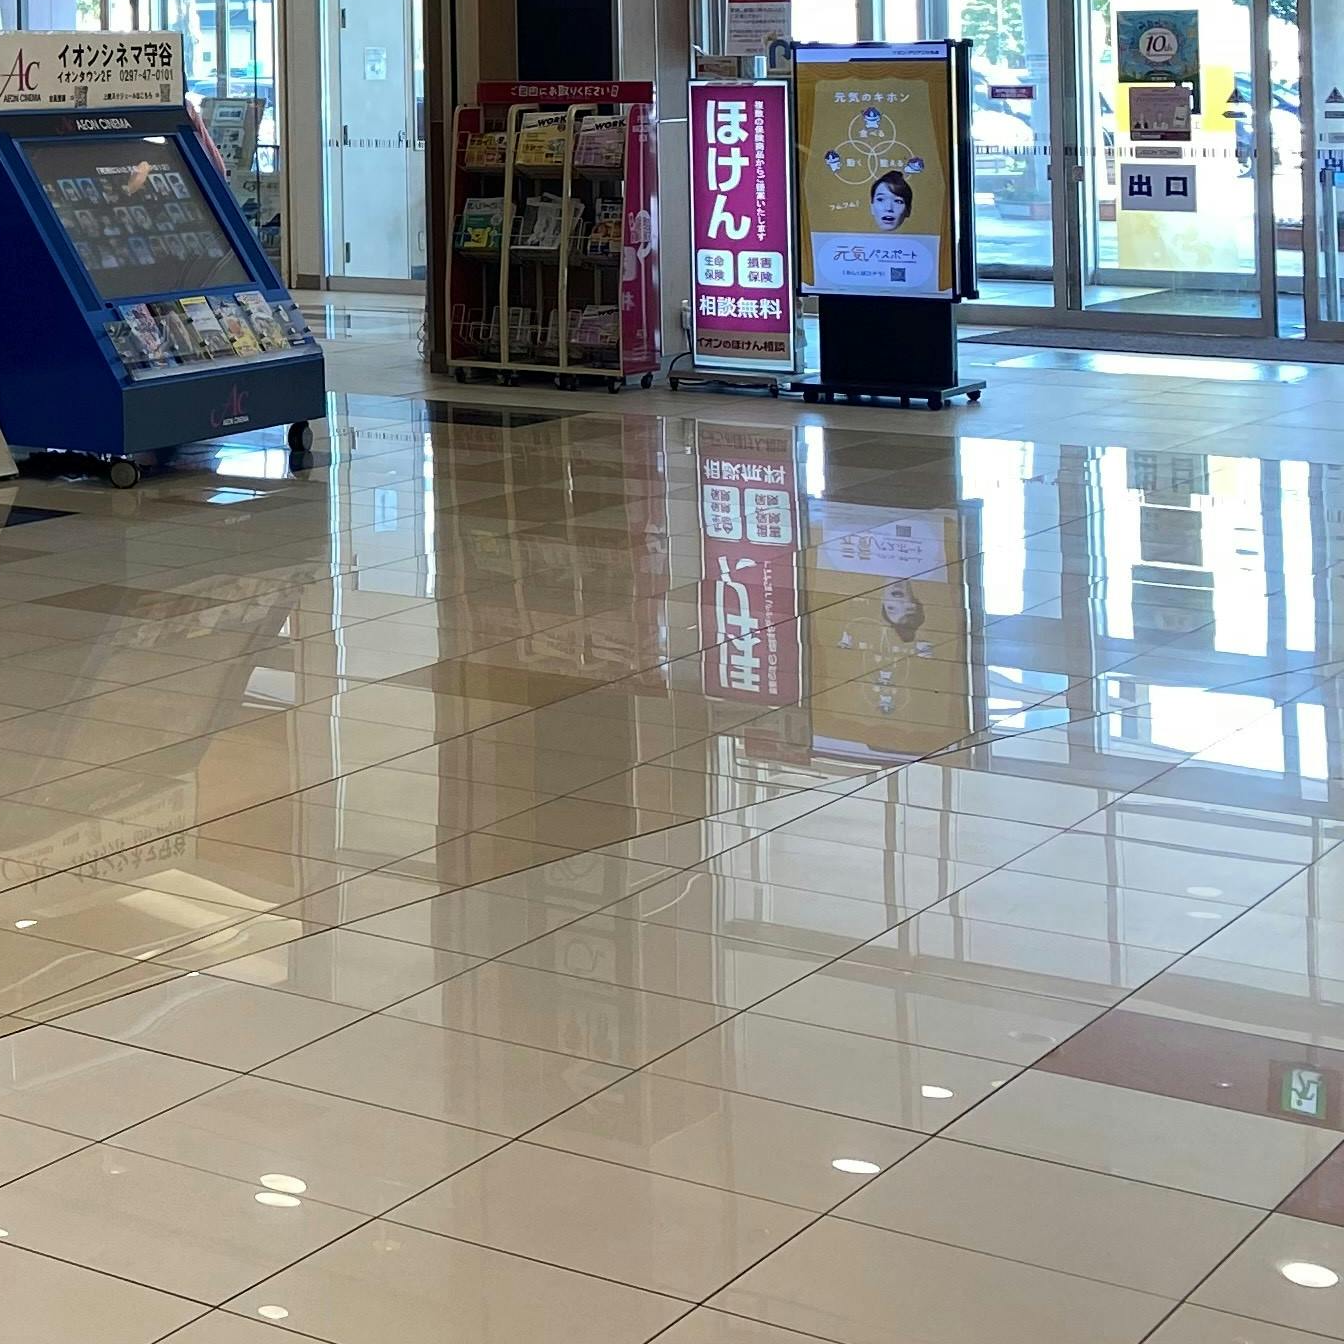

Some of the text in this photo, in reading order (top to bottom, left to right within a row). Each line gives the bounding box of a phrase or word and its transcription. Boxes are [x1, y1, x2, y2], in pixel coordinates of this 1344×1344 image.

[1145, 35, 1165, 53] 10
[58, 41, 174, 69] イオンシネマ守谷
[57, 70, 113, 83] イオンタウン2F
[510, 84, 610, 98] ご自由にお取りください
[833, 91, 910, 104] 元気のキホン
[99, 117, 132, 131] CINEMA
[706, 99, 752, 241] ほけん
[1128, 174, 1188, 197] 出口
[832, 245, 918, 263] 元気パスポート
[747, 257, 773, 269] 損害
[747, 271, 774, 283] 保険
[699, 294, 783, 320] 相談無料
[696, 337, 786, 353] イオンのほけん相談
